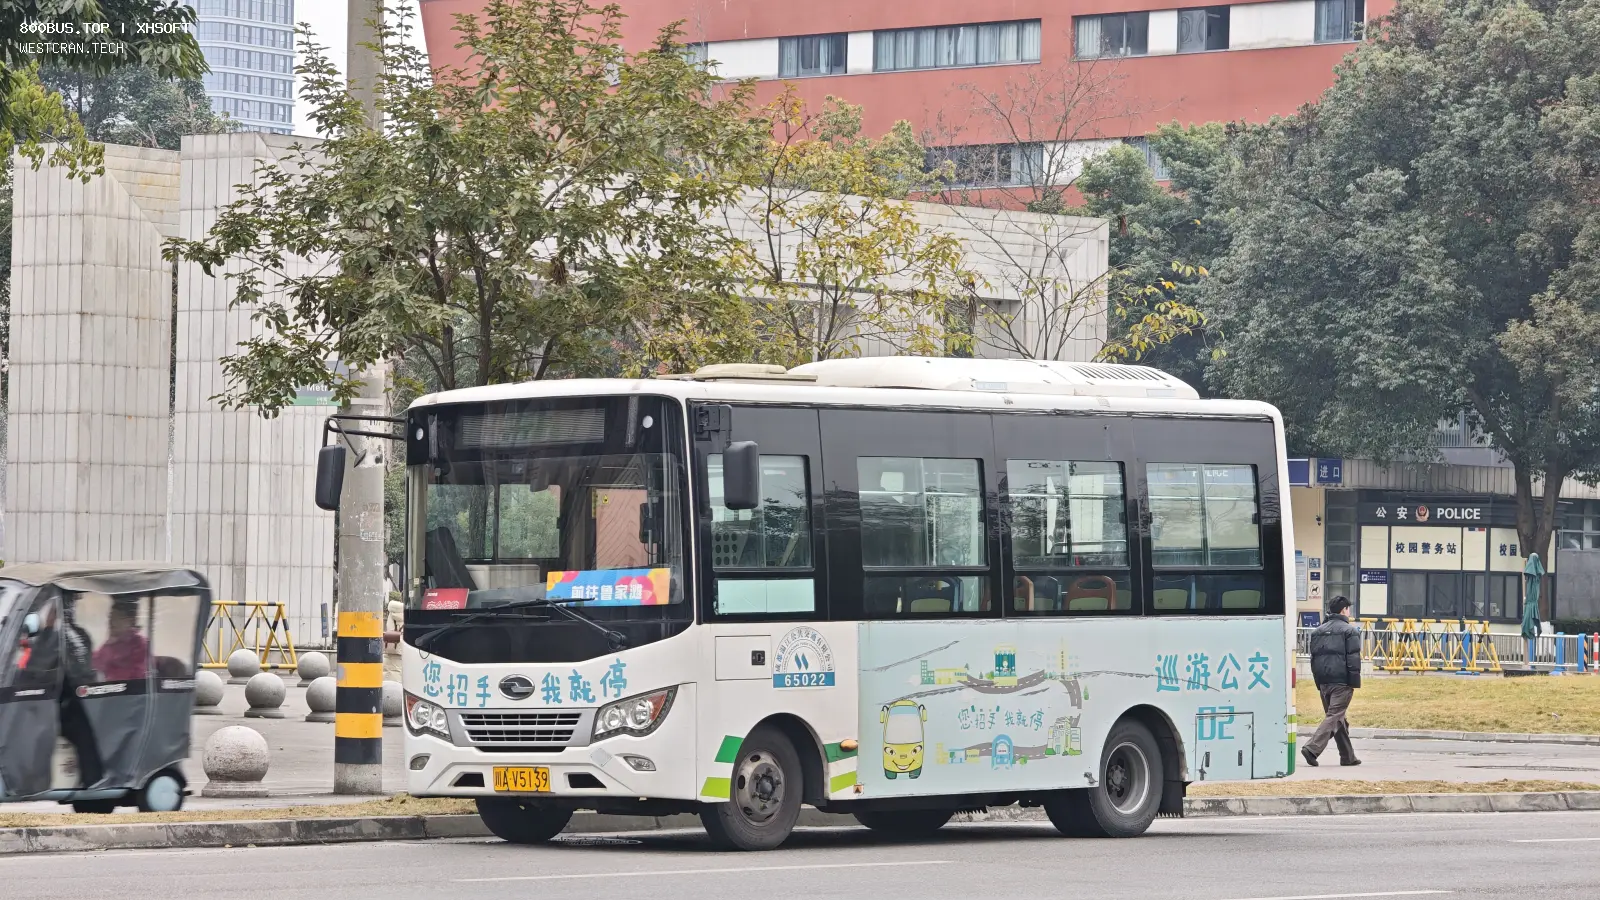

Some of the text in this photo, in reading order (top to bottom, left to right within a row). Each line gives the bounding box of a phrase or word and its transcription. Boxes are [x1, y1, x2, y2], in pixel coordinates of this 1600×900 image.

[306, 382, 333, 391] Metr
[1192, 469, 1229, 477] PLICE
[1319, 464, 1340, 479] 进口
[1376, 506, 1481, 520] 公安 POLICE
[1395, 542, 1457, 555] 校园警务站
[1499, 543, 1517, 556] 校园
[571, 584, 643, 601] 前往鲁家滩
[1155, 651, 1271, 692] 巡游公交
[422, 658, 628, 707] 您招手 我就停
[784, 673, 826, 687] 65022
[1004, 708, 1045, 731] 我就停
[1198, 706, 1235, 740] 02
